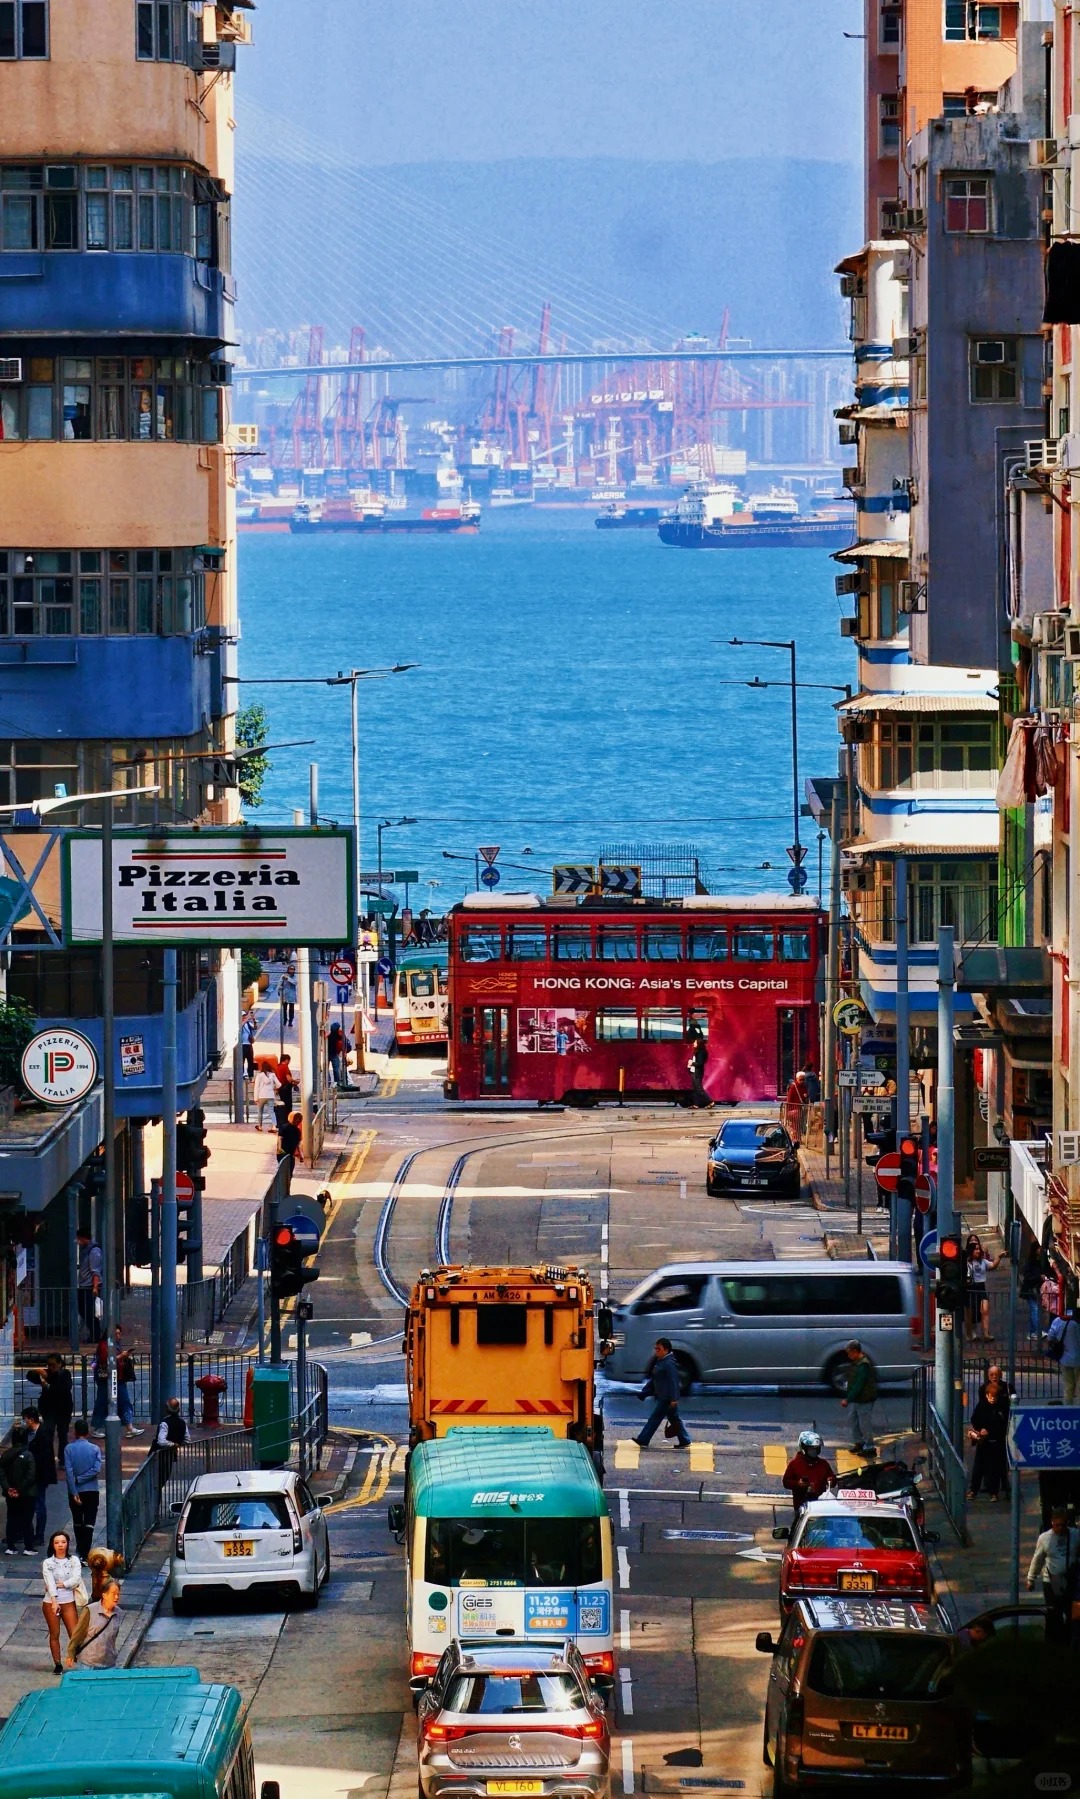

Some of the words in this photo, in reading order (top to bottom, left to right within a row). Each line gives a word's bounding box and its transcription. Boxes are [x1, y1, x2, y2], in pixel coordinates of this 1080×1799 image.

[591, 491, 626, 500] MAERSK
[118, 864, 301, 887] Pizzeria
[141, 890, 278, 912] Italia
[533, 977, 580, 989] HONG
[585, 977, 635, 989] KONG:
[639, 978, 682, 989] Asia's
[685, 978, 734, 990] Events
[738, 979, 788, 991] Capital
[37, 1037, 80, 1051] PIZZERIA
[43, 1087, 76, 1097] ITALIA
[483, 1291, 495, 1300] AM
[1029, 1417, 1080, 1431] Victor
[1030, 1438, 1080, 1459] 域多
[472, 1491, 510, 1504] AMS
[840, 1490, 873, 1498] TAXI
[226, 1548, 252, 1556] 3552
[846, 1581, 869, 1590] 3331
[464, 1597, 493, 1609] GIES
[529, 1596, 559, 1606] 11.20
[578, 1596, 606, 1606] 11.23
[856, 1727, 871, 1737] LT
[495, 1782, 510, 1791] VL
[515, 1782, 534, 1791] 160
